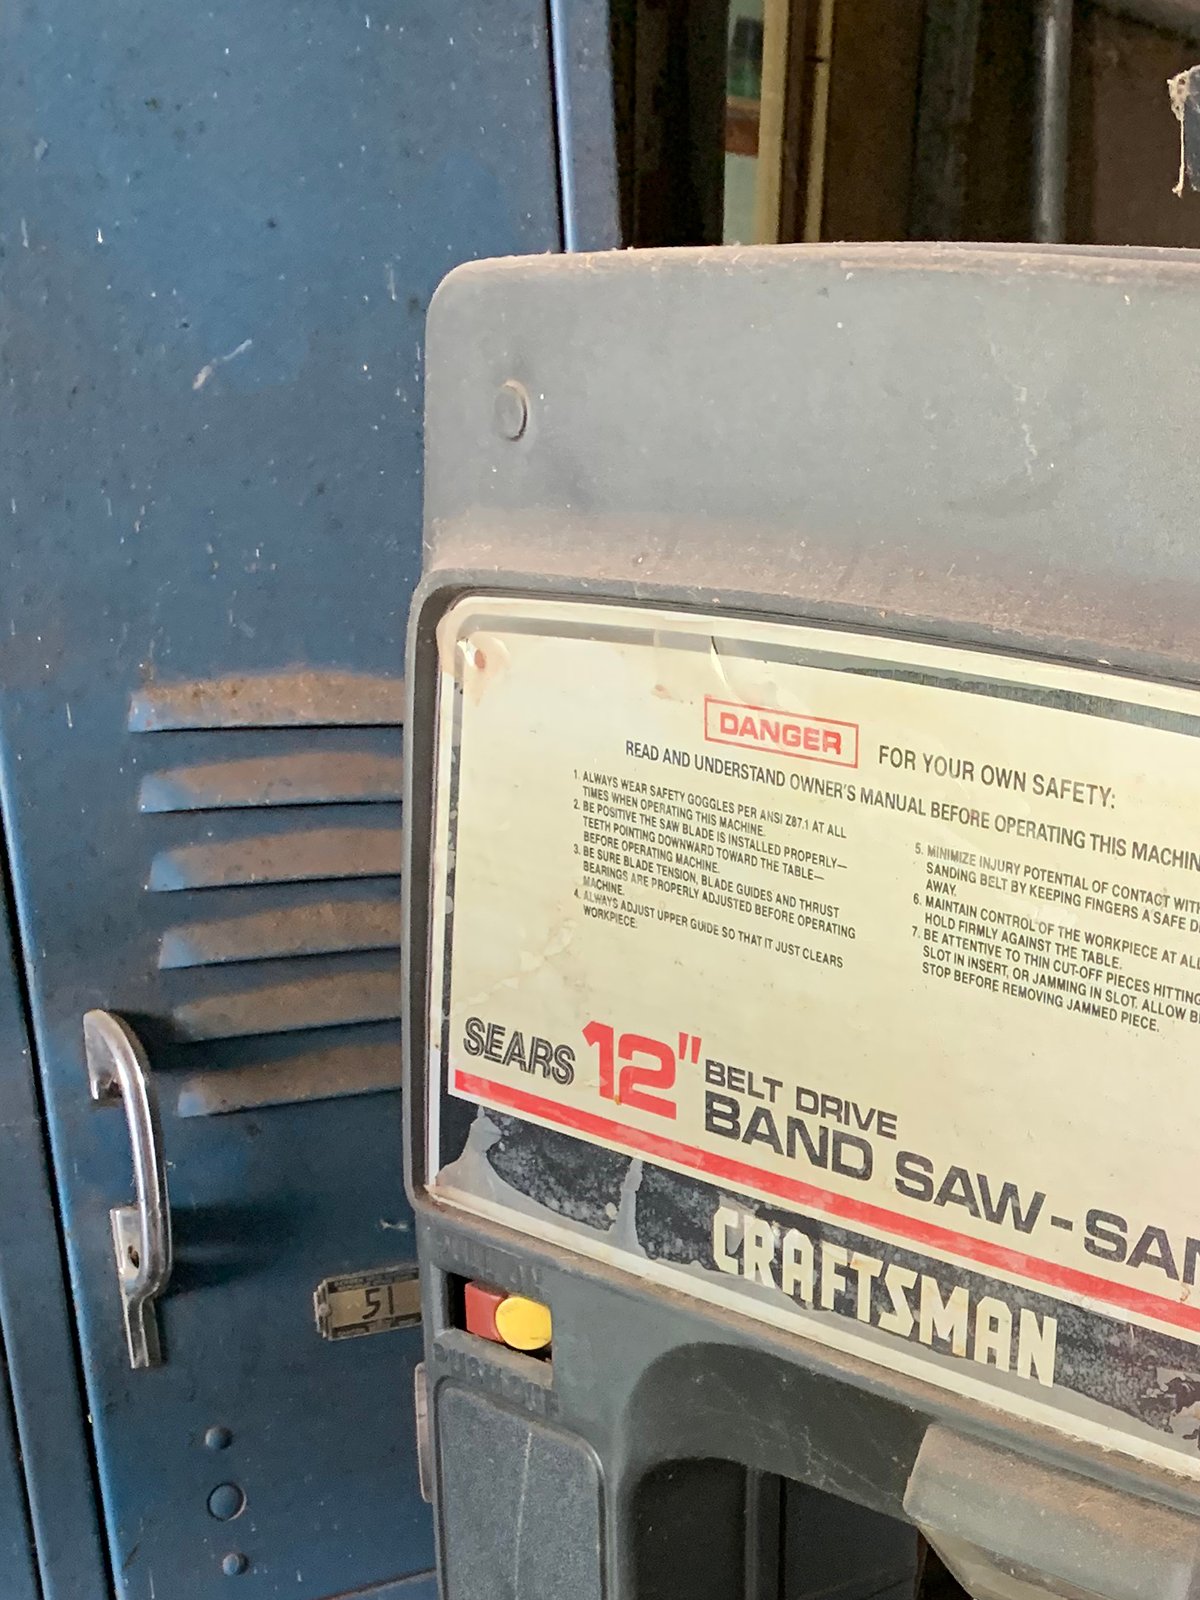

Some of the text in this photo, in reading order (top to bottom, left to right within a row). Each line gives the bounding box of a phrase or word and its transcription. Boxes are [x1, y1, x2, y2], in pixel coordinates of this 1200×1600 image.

[719, 711, 842, 755] DANGER
[625, 739, 660, 761] READ
[660, 747, 693, 768] AND
[692, 753, 786, 787] UNDERSTAND
[860, 786, 927, 817] MANUAL
[930, 800, 990, 830] BEFORE
[994, 814, 1086, 849] OPERATING
[1089, 833, 1127, 857] THIS
[879, 744, 916, 771] FOR
[922, 752, 975, 782] YOUR
[980, 764, 1026, 793] OWN
[573, 798, 581, 810] 2.
[582, 800, 595, 814] BE
[596, 803, 638, 824] POSITIVE
[638, 812, 658, 828] THE
[659, 817, 681, 833] SAW
[682, 822, 715, 842] BLADE
[716, 830, 726, 844] IS
[728, 833, 782, 857] INSTALLED
[582, 770, 847, 839] ALWAYS WEAR SAFETY GOGGLES PER ANSI Z87.1 AT ALL
[582, 785, 609, 802] TIMES
[611, 791, 638, 809] WHEN
[640, 798, 693, 821] OPERATING
[695, 810, 717, 827] THIS
[582, 815, 612, 833] TEETH
[613, 822, 656, 843] POINTING
[657, 832, 715, 857] DOWNWARD
[715, 844, 759, 867] TOWARD
[759, 857, 781, 873] THE
[583, 830, 619, 850] BEFORE
[621, 839, 673, 863] OPERATING
[915, 842, 924, 855] 5.
[927, 844, 977, 867] MINIMIZE
[979, 855, 1021, 876] INJURY
[1023, 864, 1089, 891] POTENTIAL
[1091, 879, 1109, 894] OF
[1111, 883, 1171, 909] CONTACT
[573, 843, 581, 856] 3.
[583, 845, 595, 859] BE
[597, 848, 622, 866] SURE
[622, 855, 654, 874] BLADE
[701, 874, 734, 893] BLADE
[736, 882, 774, 903] GUIDES
[775, 893, 797, 908] AND
[798, 898, 840, 919] THRUST
[583, 860, 856, 940] BEARINGS ARE PROPERLY ADJUSTED BEFORE OPERATING
[926, 861, 977, 884] SANDING
[979, 872, 1009, 891] BELT
[1010, 879, 1027, 895] BY
[1029, 883, 1082, 907] KEEPING
[1084, 895, 1139, 920] FINGERS
[1141, 907, 1152, 923] A
[1151, 909, 1187, 931] SAFE
[573, 888, 844, 969] 4. ALWAYS ADJUST UPPER GUIDE SO THAT IT JUST CLEARS
[913, 892, 922, 906] 6.
[925, 894, 978, 919] MAINTAIN
[980, 907, 1038, 933] CONTROL
[1037, 920, 1055, 936] OF
[1057, 925, 1081, 943] THE
[1084, 931, 1158, 961] WORKPIECE
[1161, 949, 1178, 964] AT
[923, 928, 939, 944] BE
[941, 932, 1002, 959] ATTENTIVE
[1003, 947, 1021, 963] TO
[1022, 951, 1051, 971] THIN
[1052, 959, 1104, 982] CUT-OFF
[1105, 971, 1151, 994] PIECES
[924, 911, 957, 931] HOLD
[957, 918, 999, 941] FIRMLY
[999, 930, 1052, 954] AGAINST
[1054, 942, 1078, 960] THE
[922, 944, 952, 963] SLOT
[953, 952, 965, 967] IN
[1012, 966, 1030, 985] OR
[1032, 972, 1087, 997] JAMMING
[1088, 983, 1102, 1001] IN
[1140, 996, 1187, 1021] ALLOW
[922, 961, 952, 979] STOP
[953, 968, 1000, 993] BEFORE
[1002, 981, 1064, 1009] REMOVING
[1066, 998, 1118, 1022] JAMMED
[463, 1016, 703, 1121] SEARS 12"
[705, 1059, 898, 1141] BELT DRIVE
[705, 1090, 874, 1182] BAND
[362, 1285, 394, 1320] 51
[713, 1206, 1058, 1388] CRAFTSMAN
